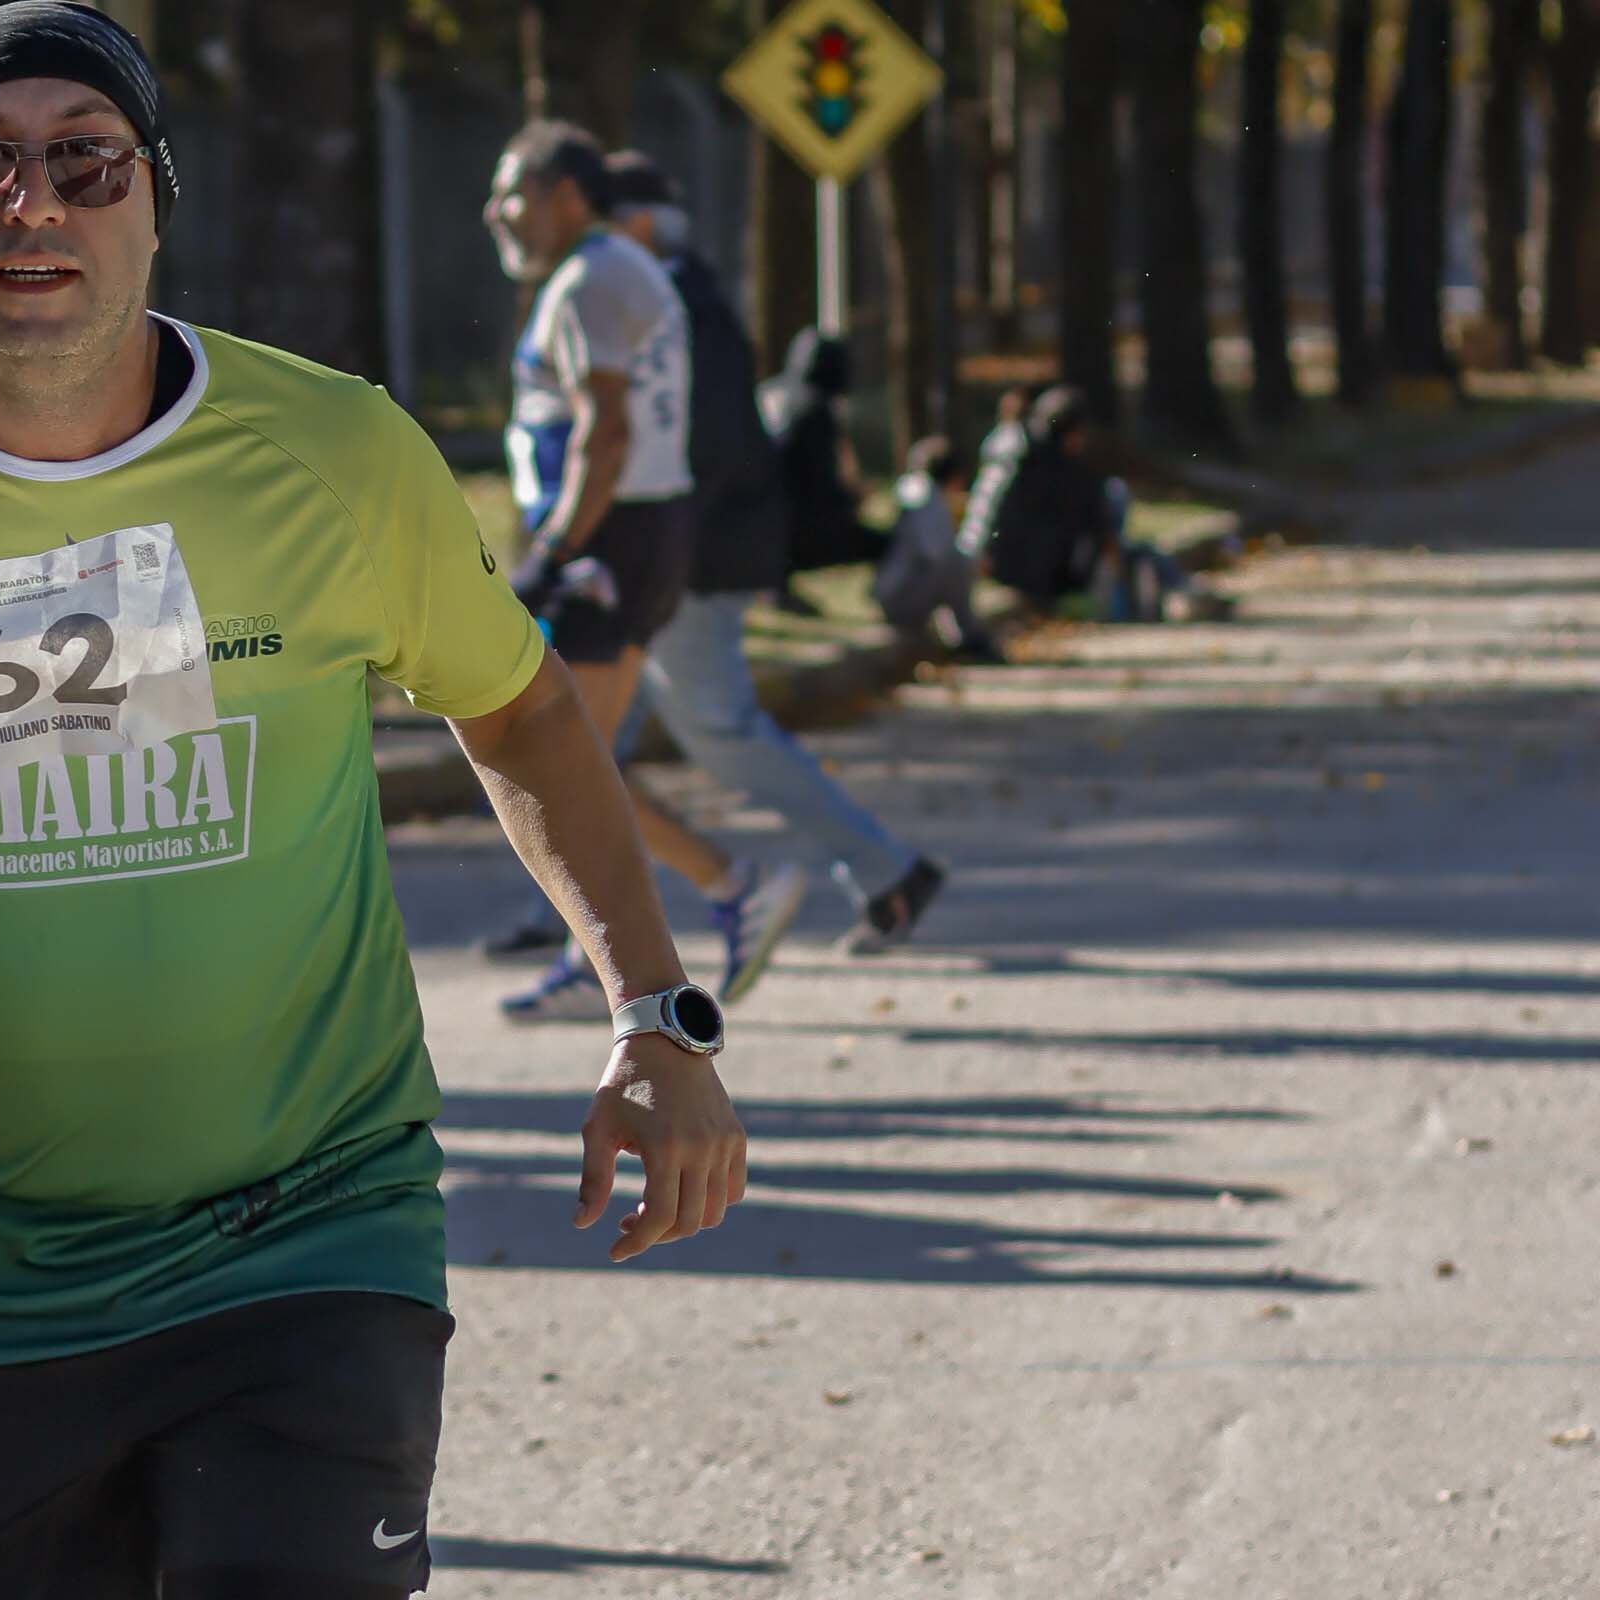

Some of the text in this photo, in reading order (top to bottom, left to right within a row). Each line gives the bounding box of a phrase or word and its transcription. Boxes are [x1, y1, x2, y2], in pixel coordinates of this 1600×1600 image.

[158, 137, 180, 199] KIPSTA
[205, 613, 277, 639] ARIO
[206, 633, 283, 662] MIS
[51, 714, 112, 731] SABATINO
[83, 836, 193, 870] Mayoristas
[199, 827, 234, 855] S.A.
